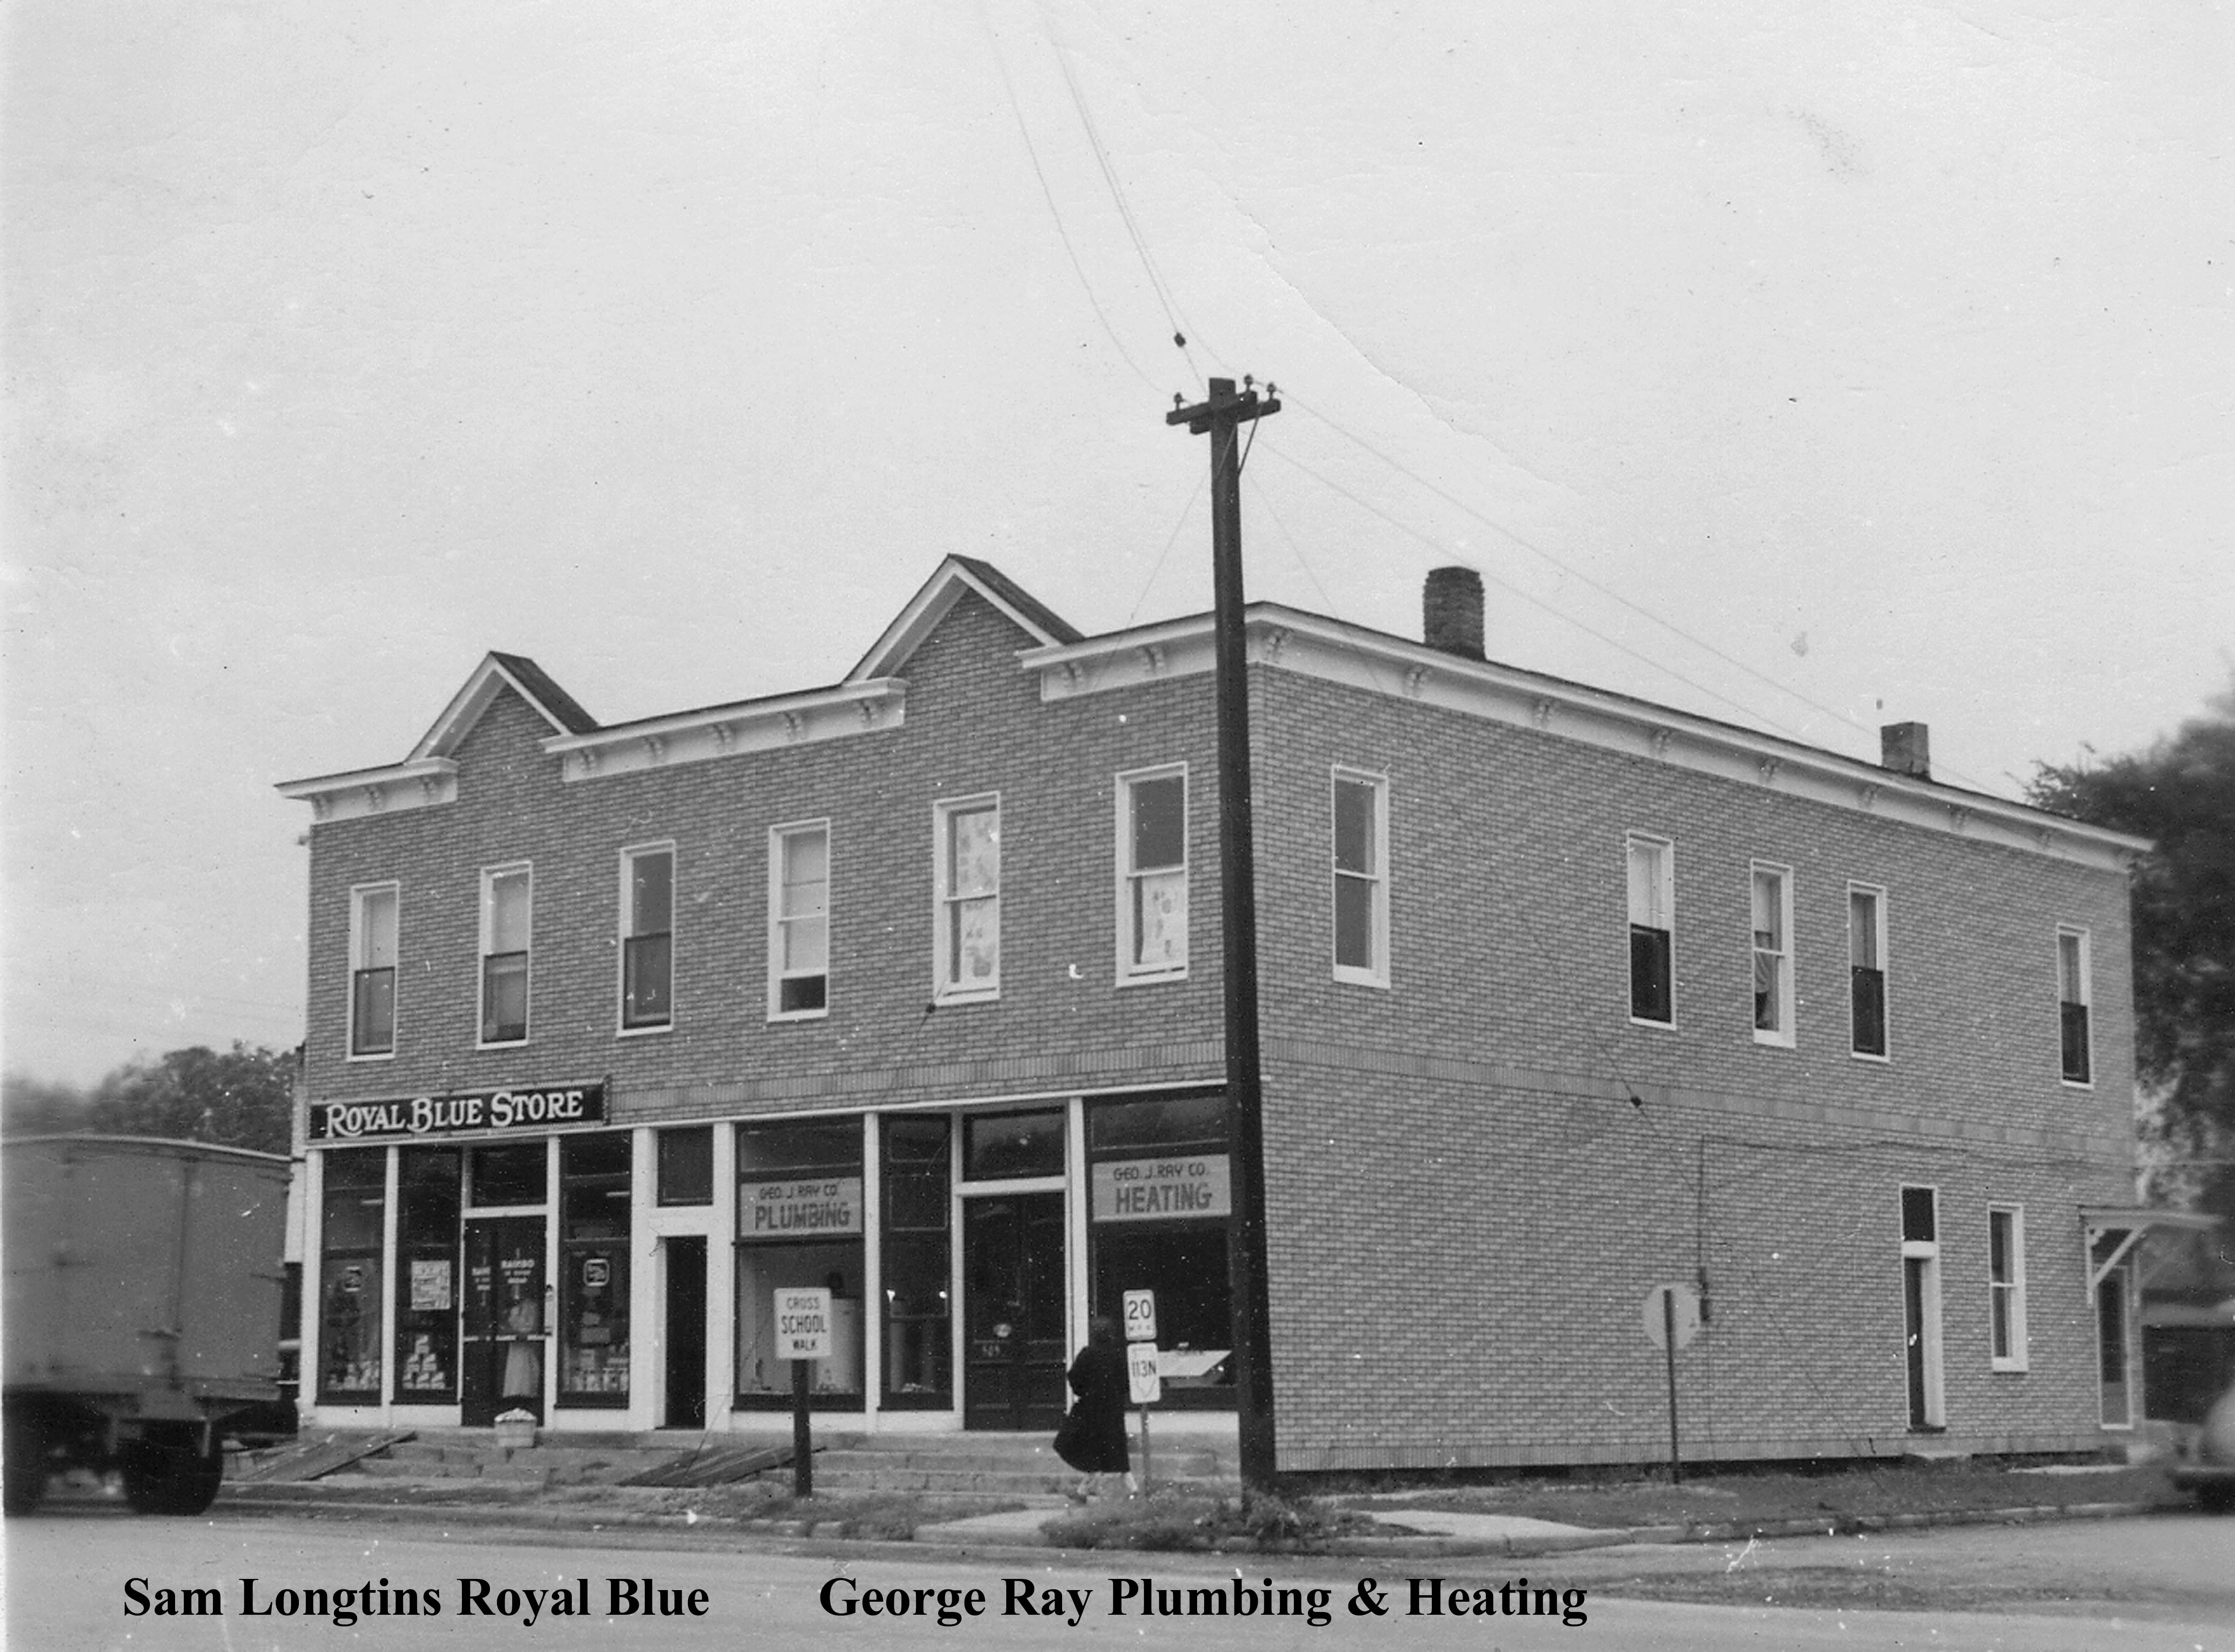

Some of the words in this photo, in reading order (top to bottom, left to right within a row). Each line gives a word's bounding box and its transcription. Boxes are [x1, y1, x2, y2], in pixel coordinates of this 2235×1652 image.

[325, 1104, 405, 1137] ROYAL
[407, 1097, 483, 1132] BLUE
[490, 1091, 583, 1127] STORE
[1116, 1182, 1212, 1213] HEATING
[755, 1202, 850, 1230] PLUMBING
[787, 1297, 820, 1310] CROSS
[1128, 1300, 1151, 1320] 20
[781, 1315, 826, 1334] SCHOOL
[792, 1338, 817, 1351] WALK
[1131, 1360, 1157, 1377] 113N
